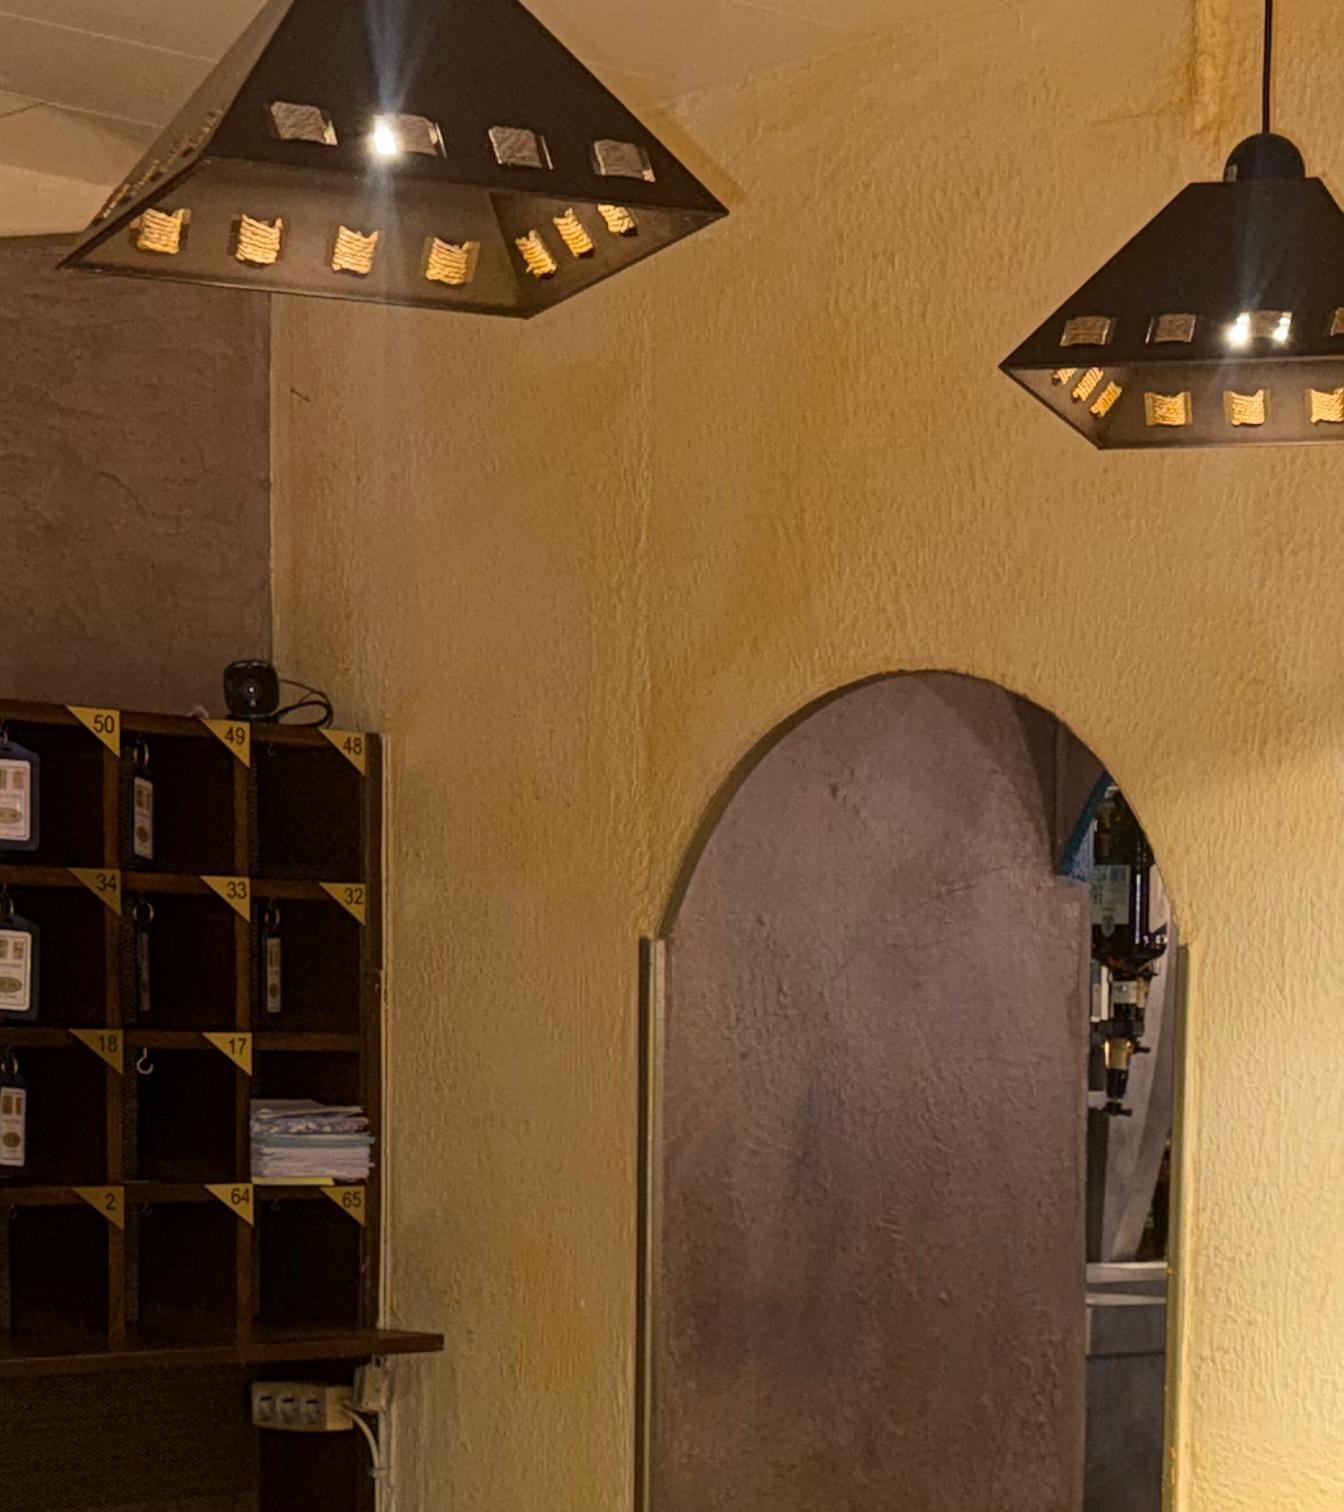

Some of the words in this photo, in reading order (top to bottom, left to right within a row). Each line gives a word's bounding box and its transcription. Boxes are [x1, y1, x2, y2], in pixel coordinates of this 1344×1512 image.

[93, 714, 116, 735] 50
[224, 726, 246, 747] 49
[342, 736, 363, 757] 48
[95, 872, 118, 893] 34
[226, 879, 248, 900] 33
[344, 886, 365, 907] 32
[97, 1034, 118, 1054] 18
[227, 1037, 247, 1057] 17
[105, 1192, 117, 1212] 2
[230, 1187, 252, 1206] 64
[342, 1190, 363, 1210] 65
